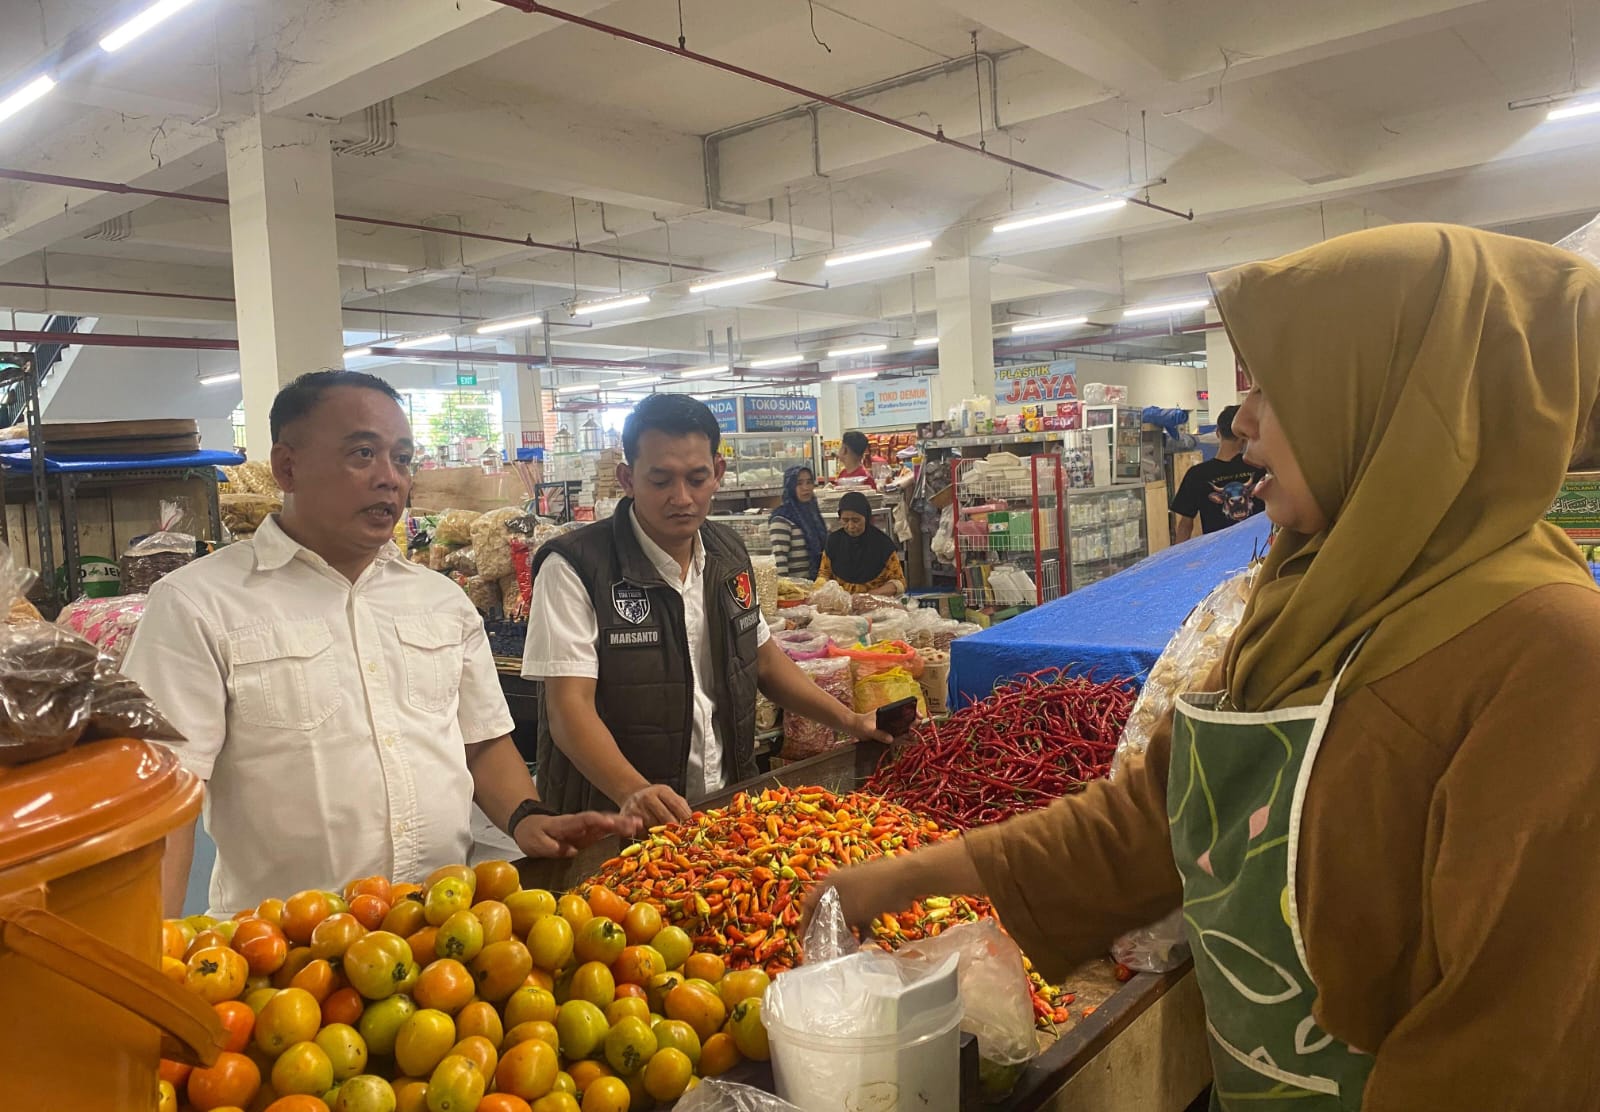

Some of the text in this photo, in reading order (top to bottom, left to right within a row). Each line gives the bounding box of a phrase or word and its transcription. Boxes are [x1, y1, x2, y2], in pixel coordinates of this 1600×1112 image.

[1000, 366, 1050, 379] PLASTIK
[460, 376, 473, 385] EXIT
[1005, 374, 1077, 404] JAYA
[880, 391, 897, 402] TOKO
[751, 399, 811, 411] TOKO SUNDA
[522, 431, 544, 442] TOILET
[610, 631, 658, 645] MARSANTO
